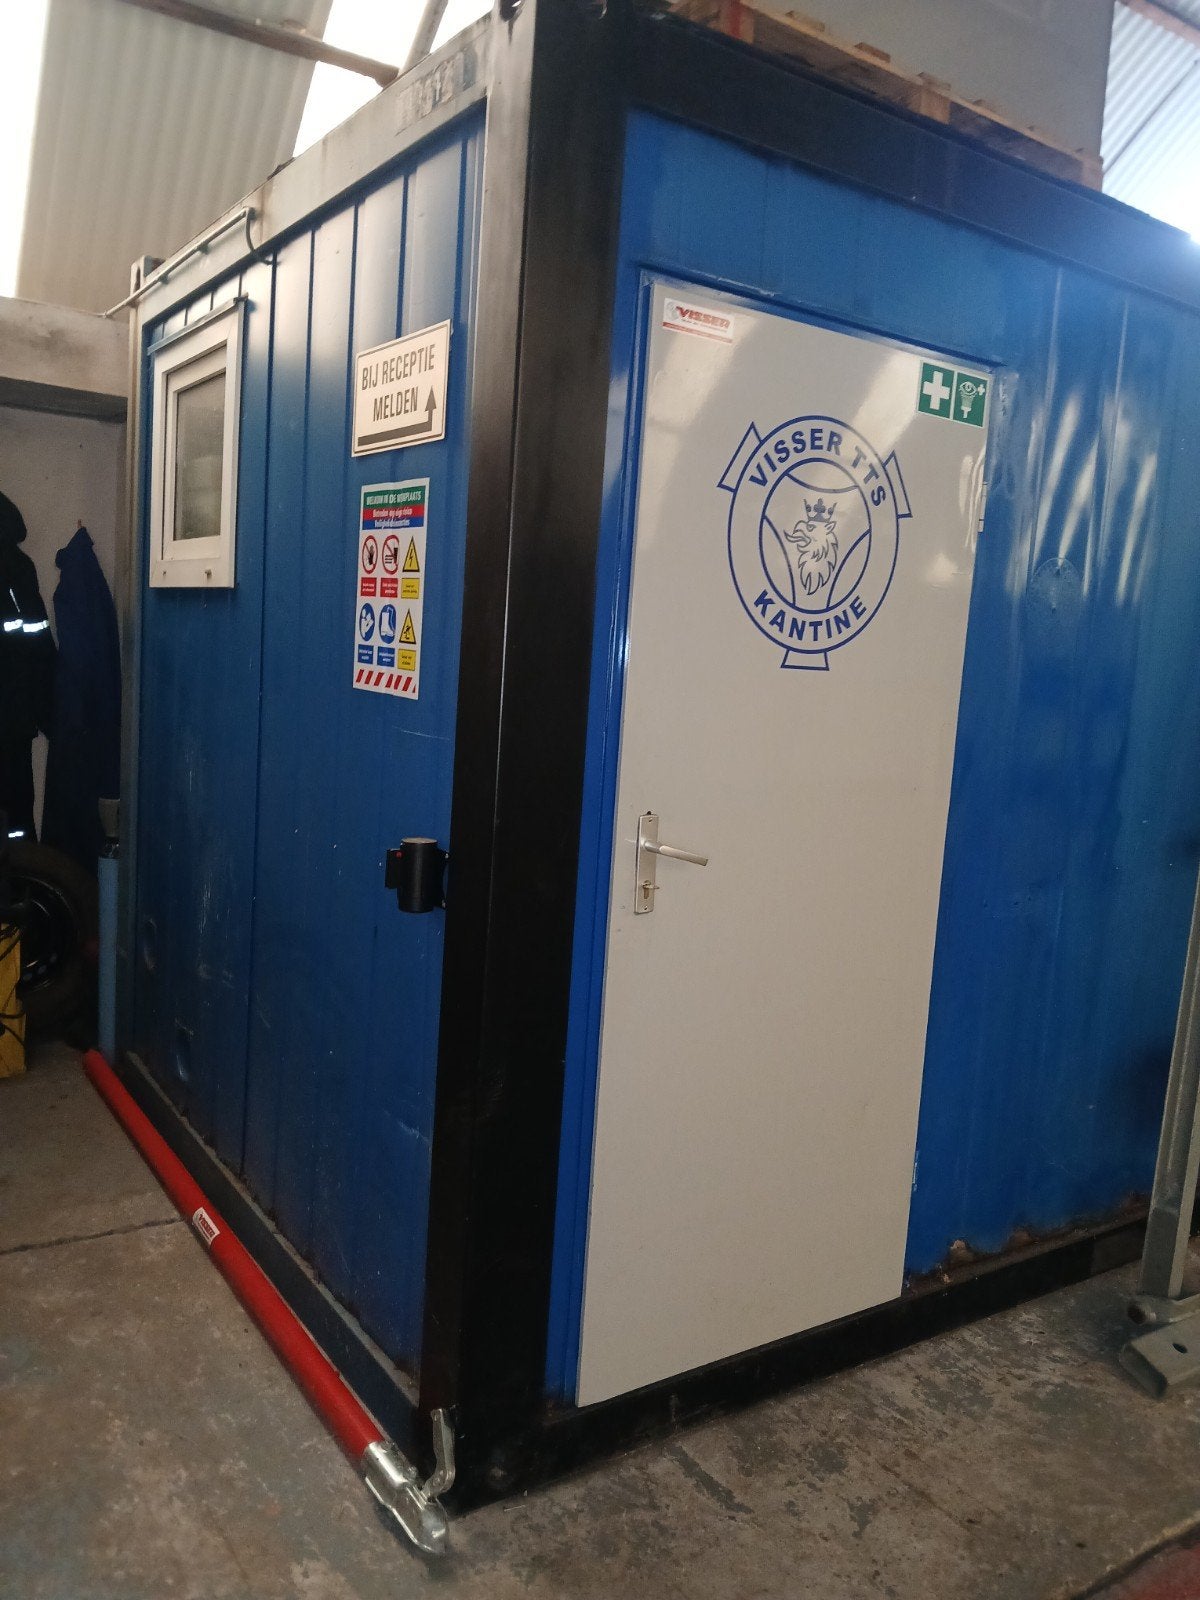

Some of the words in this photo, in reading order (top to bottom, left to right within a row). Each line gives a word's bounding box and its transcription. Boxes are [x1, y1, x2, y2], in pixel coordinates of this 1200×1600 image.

[676, 306, 730, 329] VISSER
[362, 363, 379, 390] BIJ
[382, 344, 436, 385] RECEPTIE
[373, 386, 419, 422] MELDEN
[749, 428, 843, 487] VISSER
[851, 446, 887, 507] TTS
[389, 494, 396, 504] DE
[754, 589, 867, 642] KANTINE
